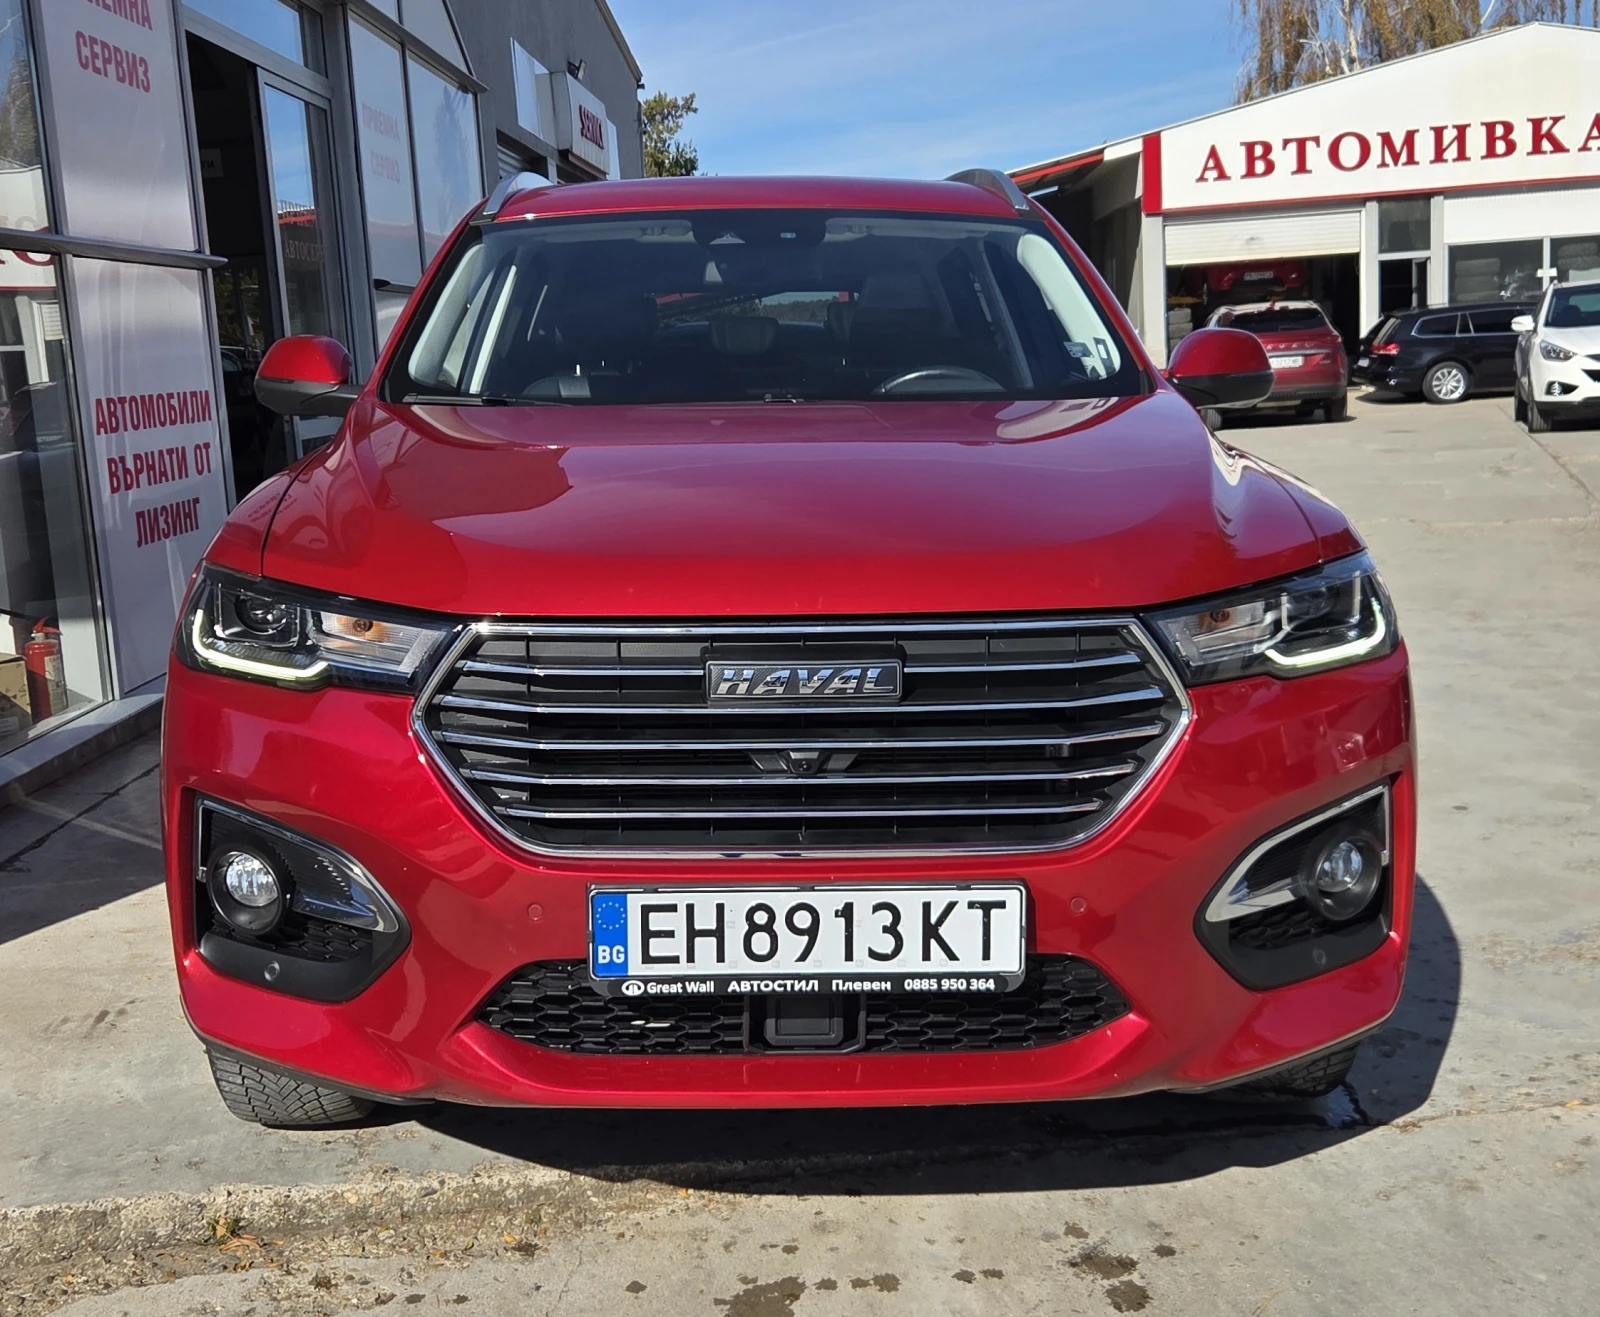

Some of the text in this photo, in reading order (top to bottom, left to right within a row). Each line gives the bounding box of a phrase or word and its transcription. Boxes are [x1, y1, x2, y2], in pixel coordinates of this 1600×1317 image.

[75, 30, 151, 94] СЕРВИЗ
[1195, 112, 1600, 183] АВТОМИВКА
[95, 390, 212, 436] АВТОМОБИЛИ
[107, 442, 212, 495] ВЪРНАТИ ОТ
[136, 497, 200, 548] ЛИЗИНГ
[717, 668, 893, 695] HAVAL
[598, 945, 625, 964] BG
[647, 981, 714, 994] Great Wall
[728, 979, 819, 992] АВТОСТИЛ
[832, 979, 891, 991] Плевен
[904, 978, 995, 991] 0885 950 364
